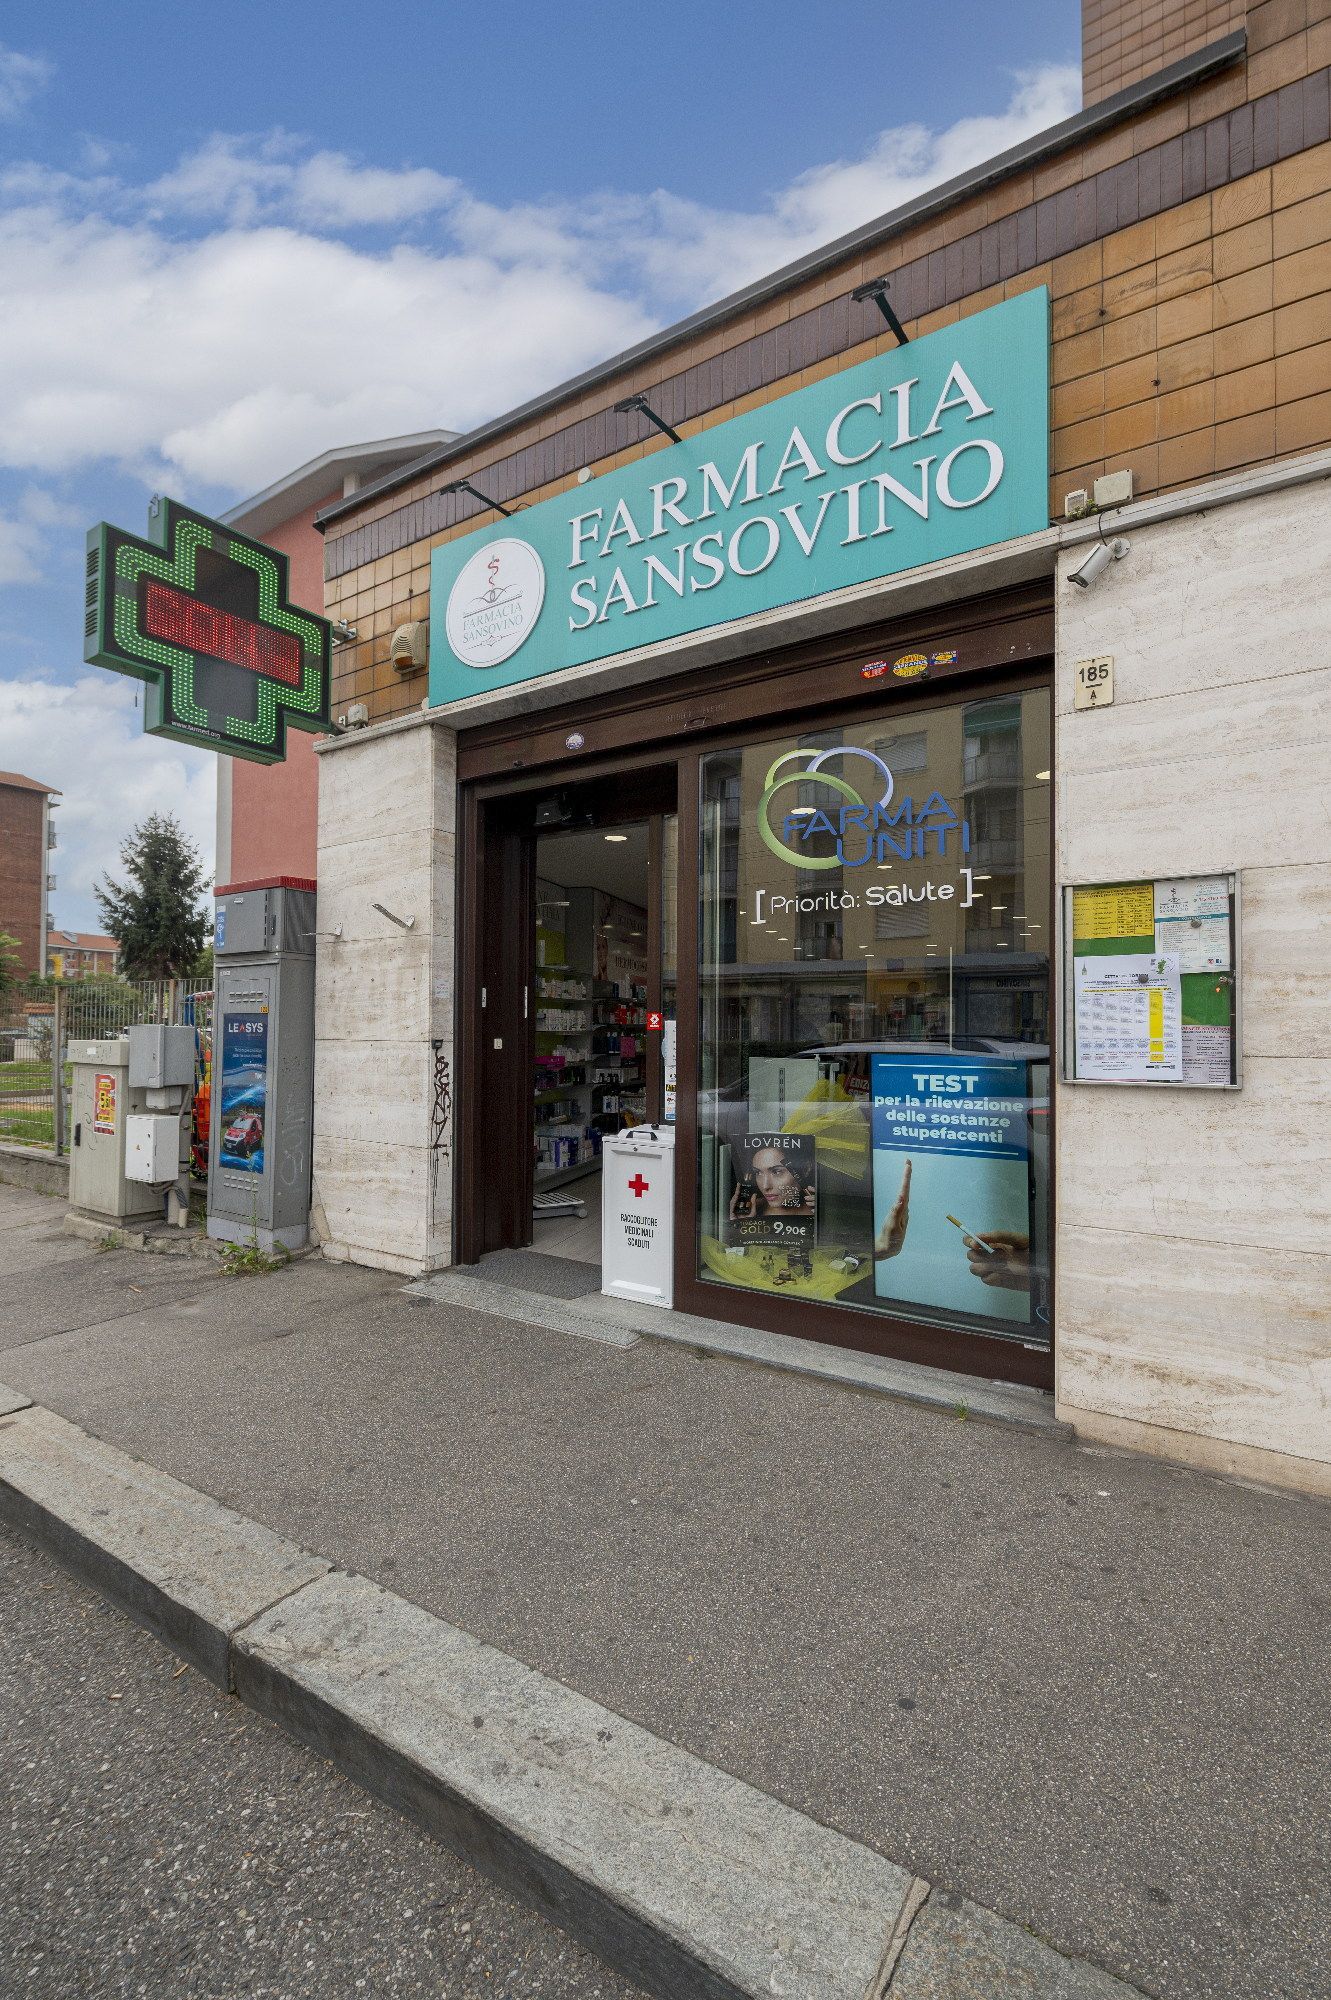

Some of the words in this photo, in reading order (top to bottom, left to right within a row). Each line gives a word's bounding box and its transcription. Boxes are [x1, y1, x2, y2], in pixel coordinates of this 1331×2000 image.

[567, 361, 993, 569] FARMACIA
[568, 439, 1005, 632] SANSOVINO
[463, 602, 522, 631] FARMACIA
[463, 614, 523, 643] SANSOVINO
[1079, 663, 1109, 682] 185
[1090, 689, 1097, 700] A
[782, 791, 958, 843] FARMA
[837, 820, 971, 867] UNITI
[866, 881, 955, 906] Salute
[913, 1073, 979, 1094] TEST
[874, 1095, 901, 1108] per
[905, 1095, 920, 1107] la
[926, 1095, 1024, 1112] rilevazione
[886, 1109, 927, 1123] delle
[930, 1112, 1011, 1128] sostanze
[892, 1125, 1003, 1144] stupefacenti
[620, 1213, 658, 1227] RACCOGLITORE
[740, 1225, 771, 1235] GOLD
[773, 1221, 806, 1236] 9,90€
[624, 1225, 654, 1238] MEDICINALI
[627, 1237, 650, 1250] SCADUTI
